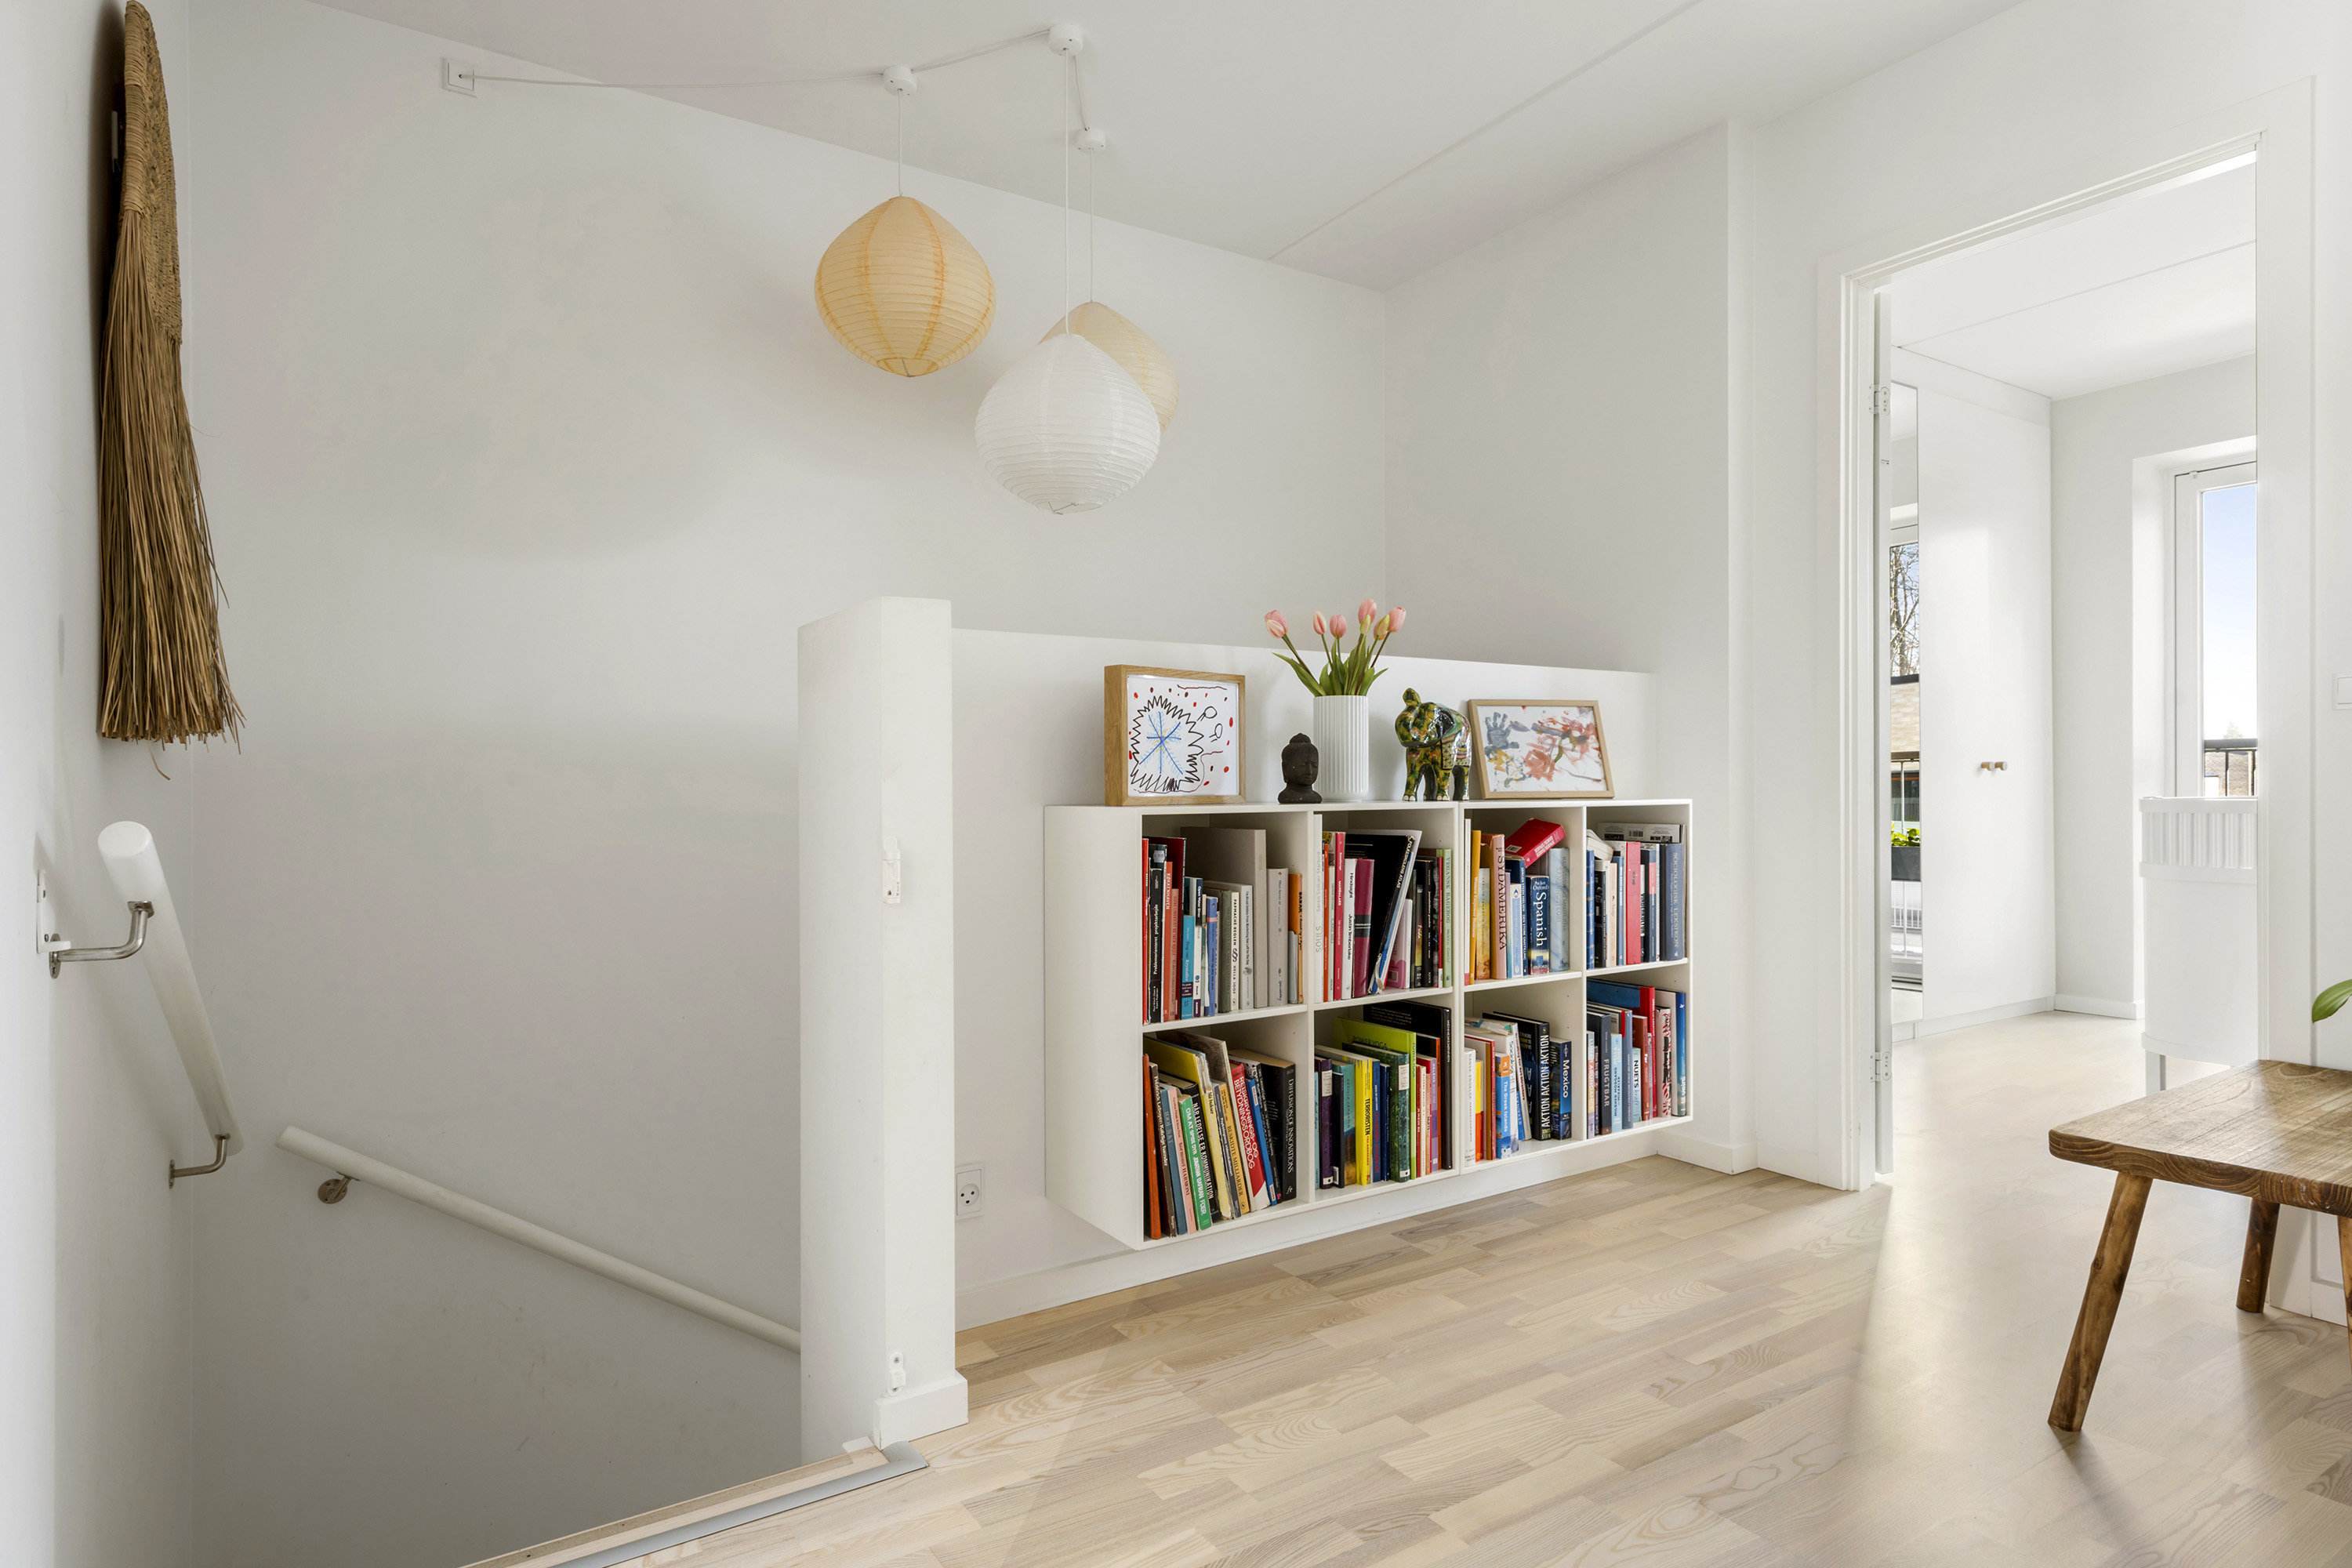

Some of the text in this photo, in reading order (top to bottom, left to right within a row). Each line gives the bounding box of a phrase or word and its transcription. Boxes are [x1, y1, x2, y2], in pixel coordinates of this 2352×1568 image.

[1497, 855, 1506, 951] SYDAMERIKA
[1533, 891, 1548, 947] Spanish
[1239, 1076, 1259, 1158] RETSKRIVNINGS- OG
[1540, 1035, 1551, 1127] AKTION AKTION AKTION
[1234, 1080, 1255, 1169] BETYDNINGSORDBOG
[1201, 1151, 1214, 1200] KOMMUNIKATION
